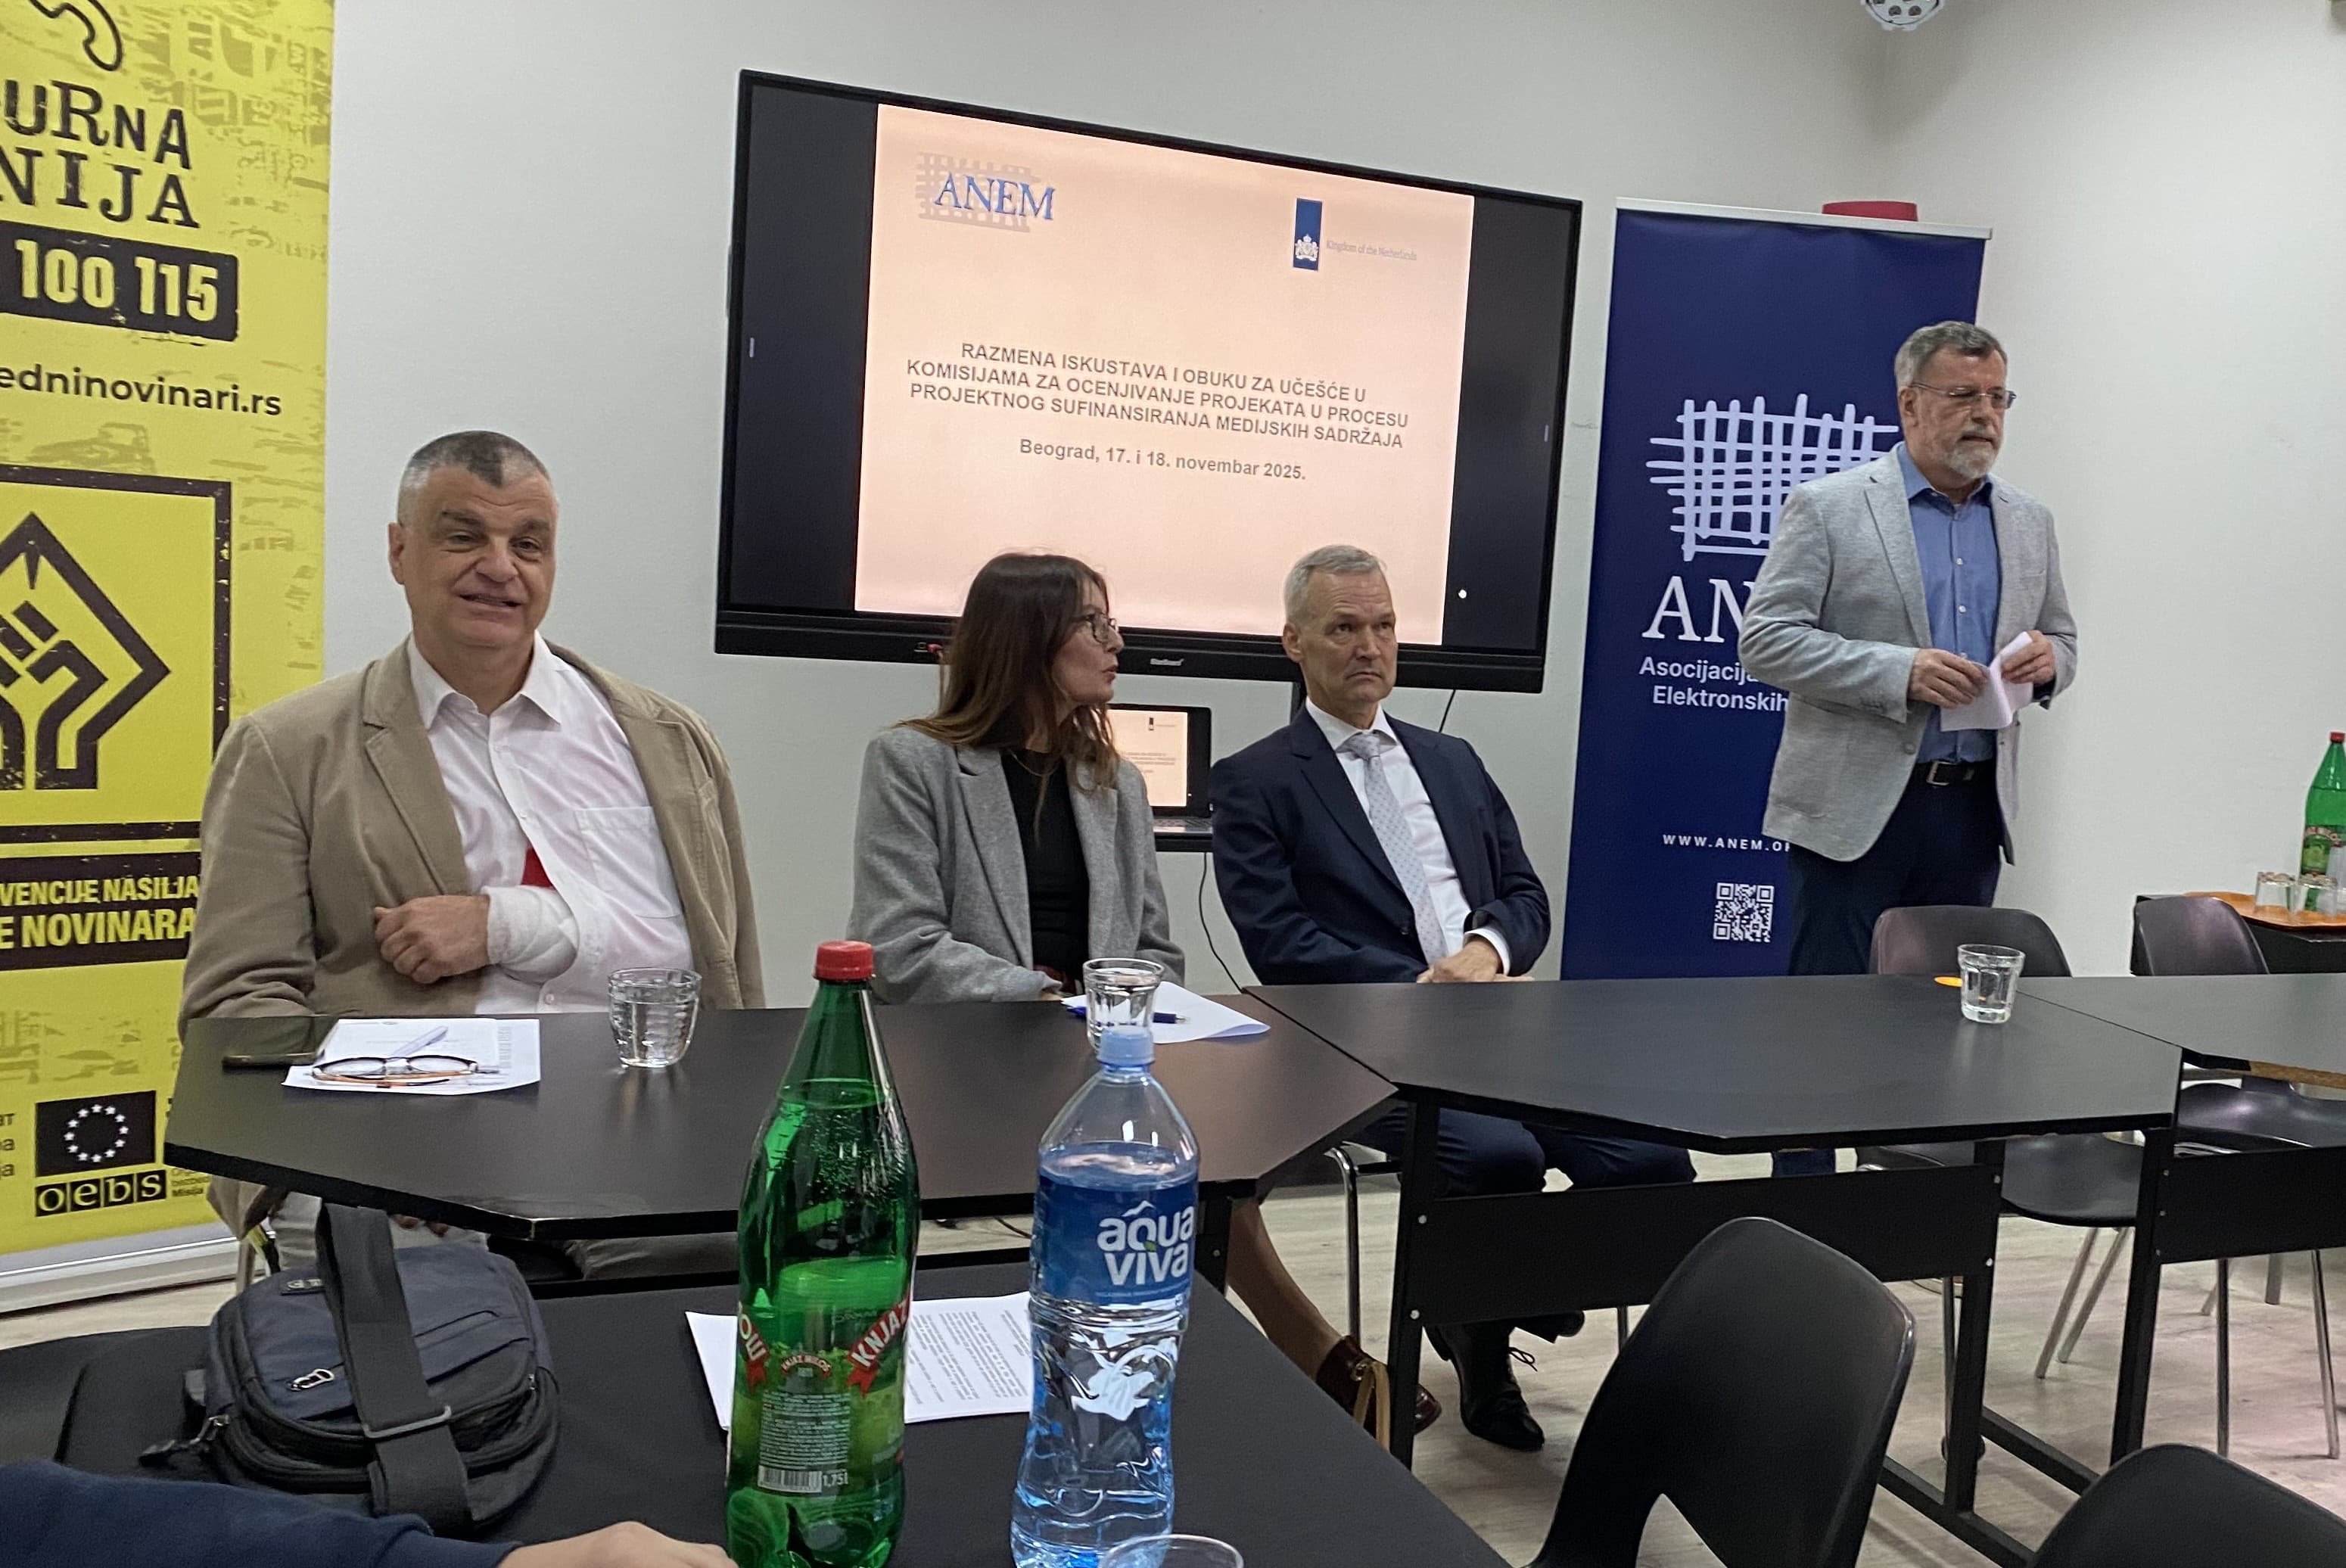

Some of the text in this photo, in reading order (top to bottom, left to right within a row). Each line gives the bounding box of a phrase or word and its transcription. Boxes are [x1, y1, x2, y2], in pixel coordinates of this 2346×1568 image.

[934, 172, 1055, 220] ANEM
[15, 239, 218, 322] 100 115
[0, 363, 282, 415] edninovinari.rs
[907, 359, 1408, 428] KOMISIJAMA ZA OCENJIVANJE PROJEKATA U PROCESU
[961, 343, 1366, 402] RAZMENA ISKUSTAVA I OBUKU ZA UČEŠĆE U
[910, 383, 1404, 448] PROJEKTNOG SUFINANSIRANJA MEDIJSKIH SADRŽAJA
[1019, 438, 1306, 480] Beograd, 17. i 18. novembar 2025.
[1653, 685, 1788, 711] Elektronskih
[103, 876, 199, 901] NASILJA
[21, 907, 196, 947] NOVINARA
[39, 1174, 162, 1211] oebs
[1104, 1243, 1189, 1285] viva
